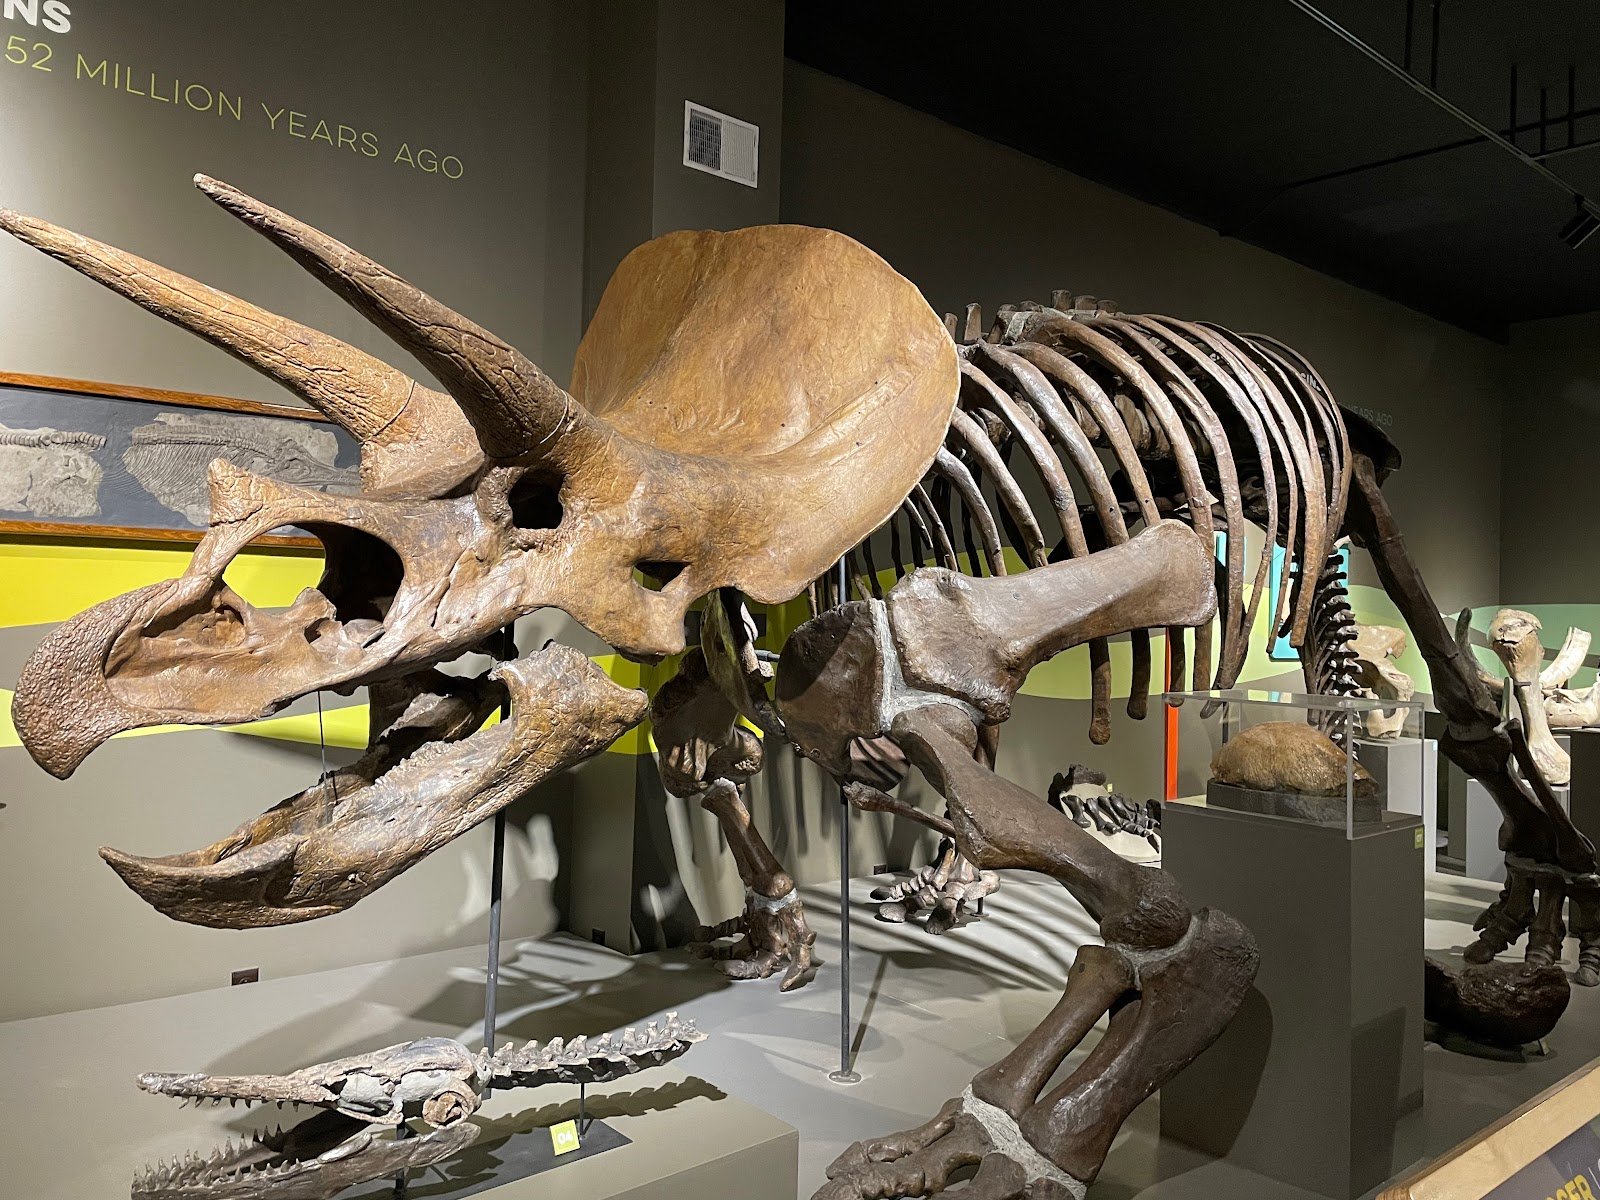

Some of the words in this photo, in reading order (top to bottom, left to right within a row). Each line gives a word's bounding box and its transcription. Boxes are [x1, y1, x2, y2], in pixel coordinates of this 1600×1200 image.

[3, 0, 71, 34] NS
[5, 36, 53, 72] 52
[75, 54, 242, 120] MILLION
[261, 103, 379, 157] YEARS
[394, 143, 464, 179] AGO
